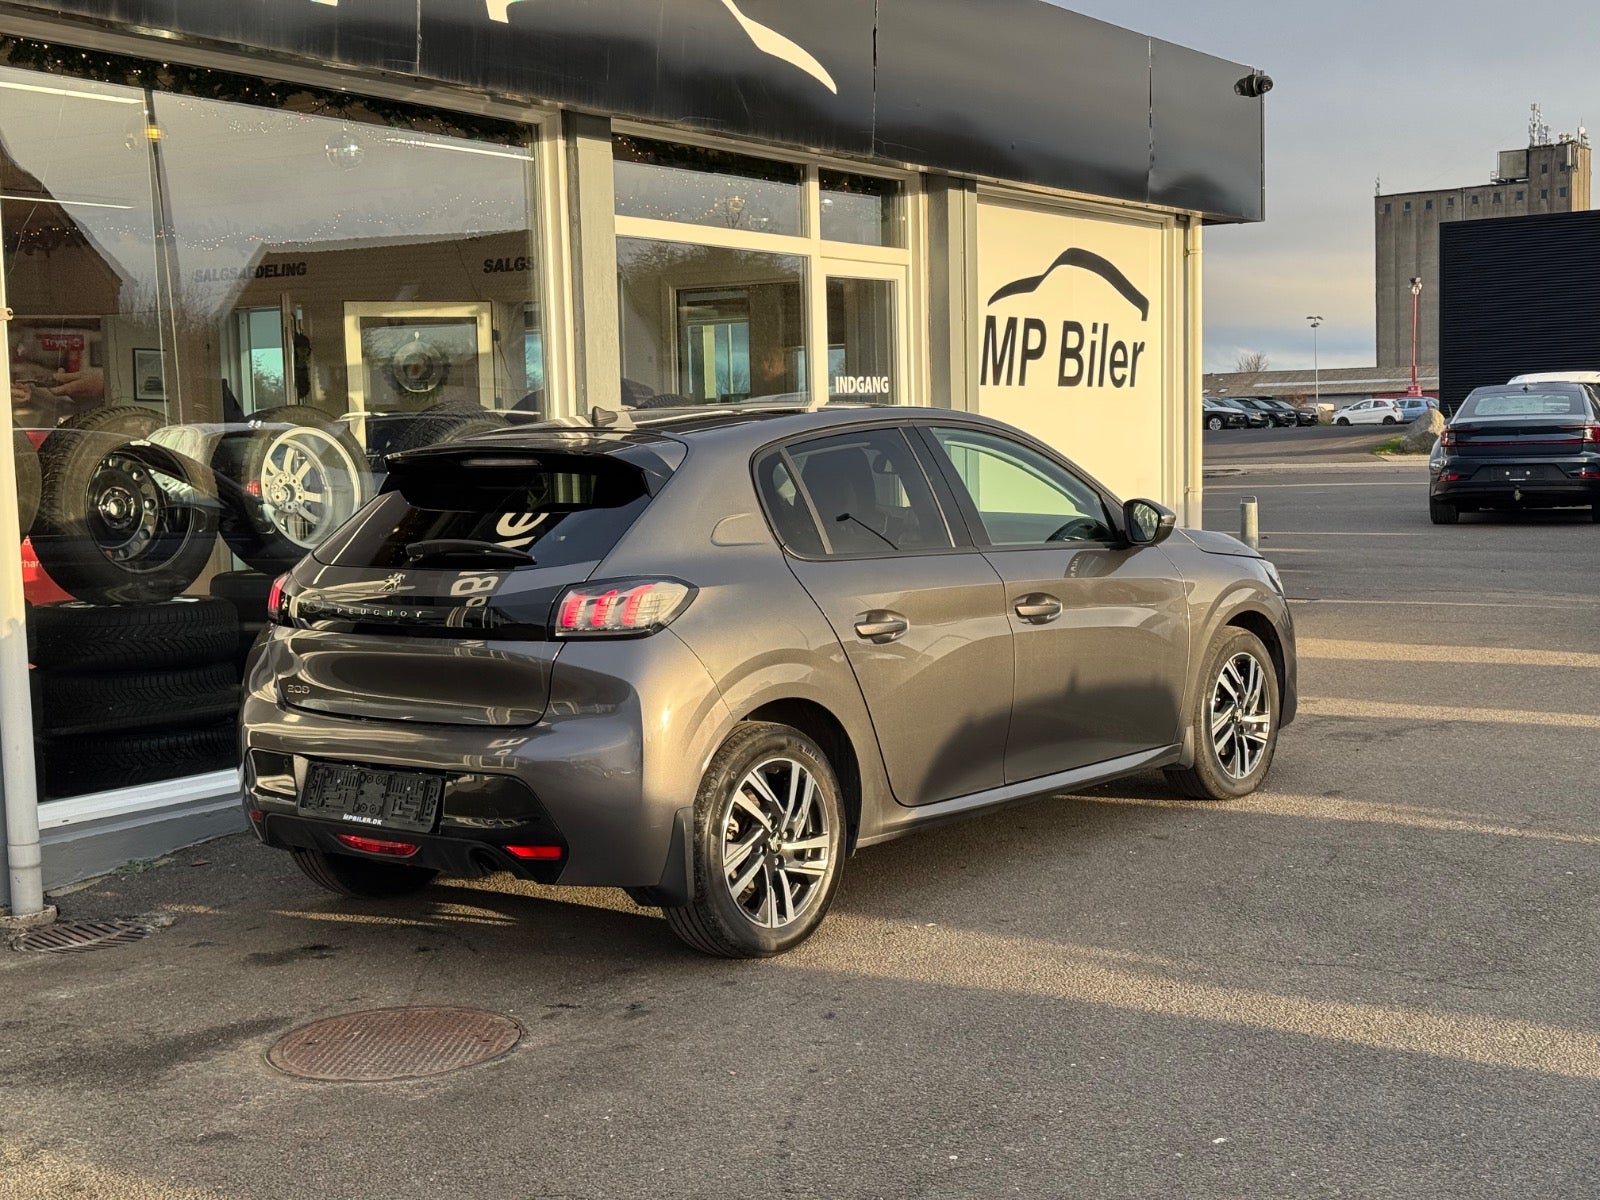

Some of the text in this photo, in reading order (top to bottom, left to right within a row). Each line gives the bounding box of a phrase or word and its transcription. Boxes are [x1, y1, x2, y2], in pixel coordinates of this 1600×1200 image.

[980, 314, 1146, 389] MP Biler
[835, 376, 890, 394] INDGANG
[287, 684, 311, 694] 208
